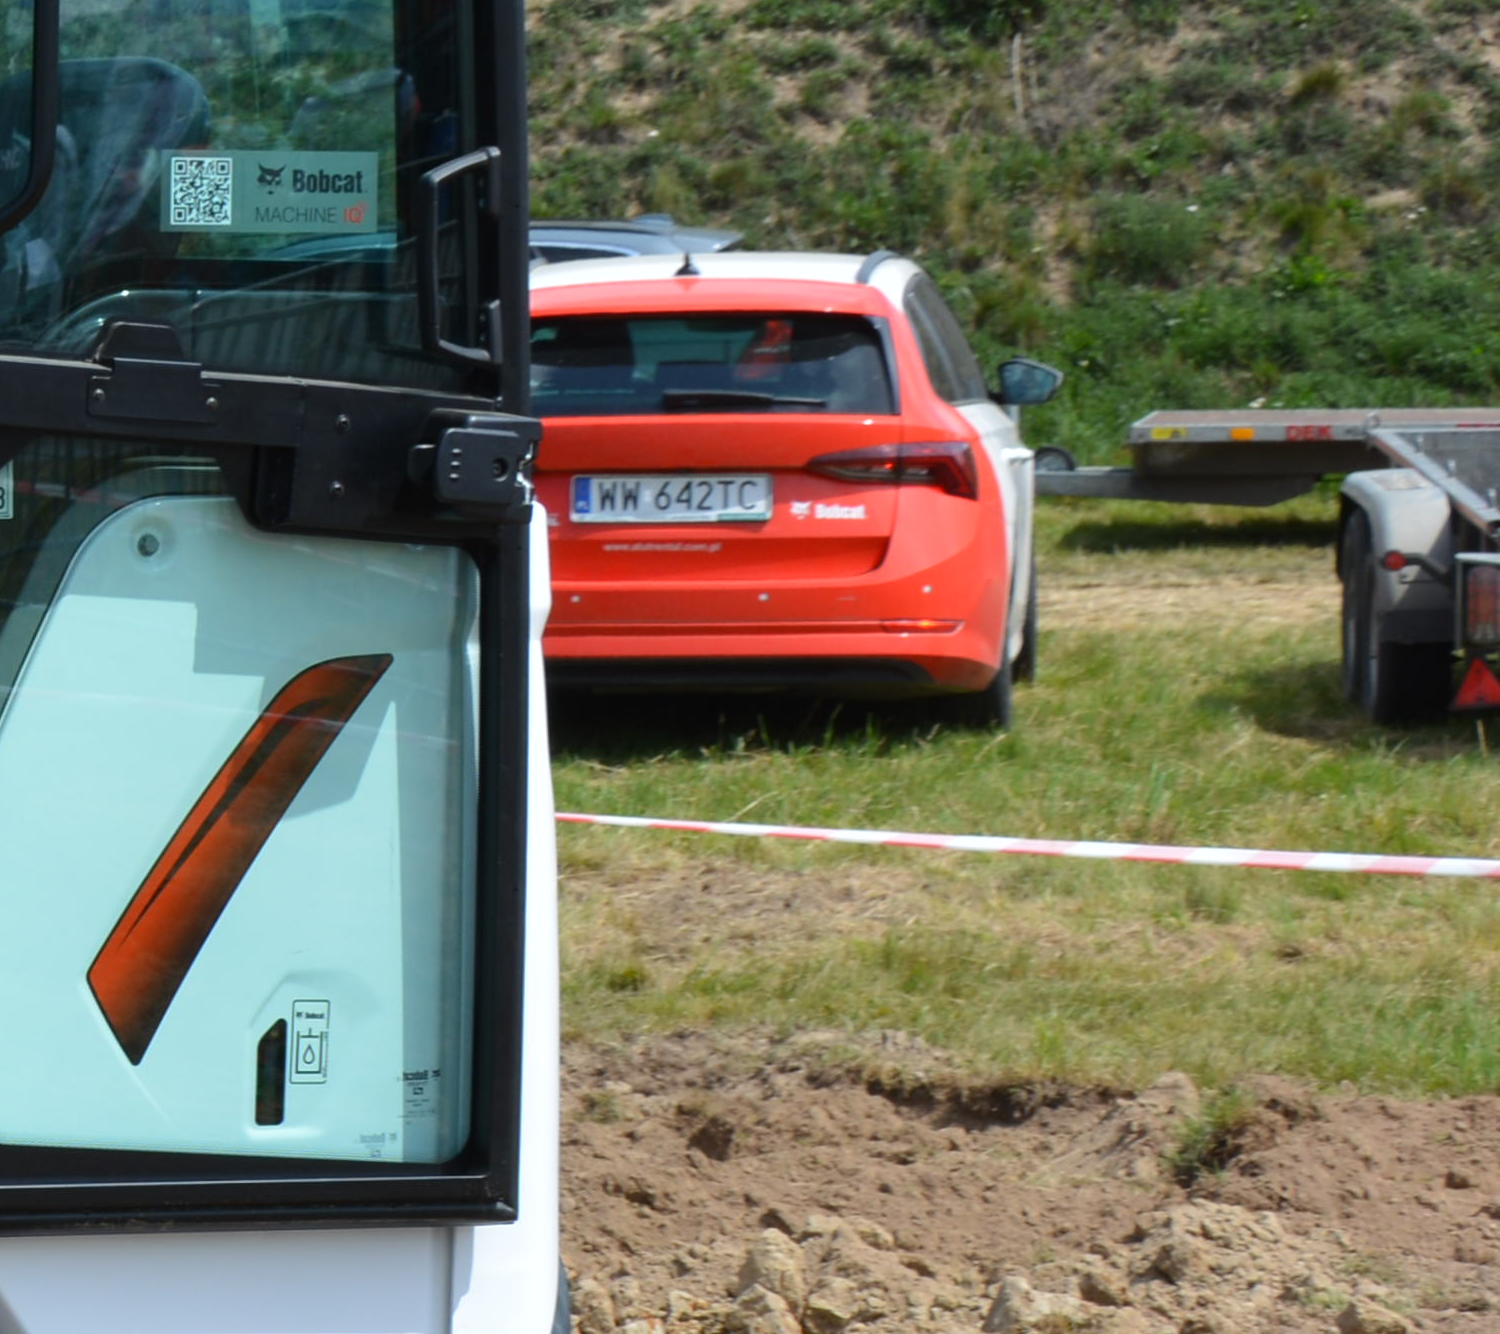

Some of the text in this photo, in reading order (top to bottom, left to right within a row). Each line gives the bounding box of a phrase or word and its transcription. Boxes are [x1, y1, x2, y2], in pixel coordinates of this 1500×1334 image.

[292, 169, 363, 194] Bobcat
[255, 207, 364, 224] MACHINE IQ
[599, 480, 758, 511] WW 642TC
